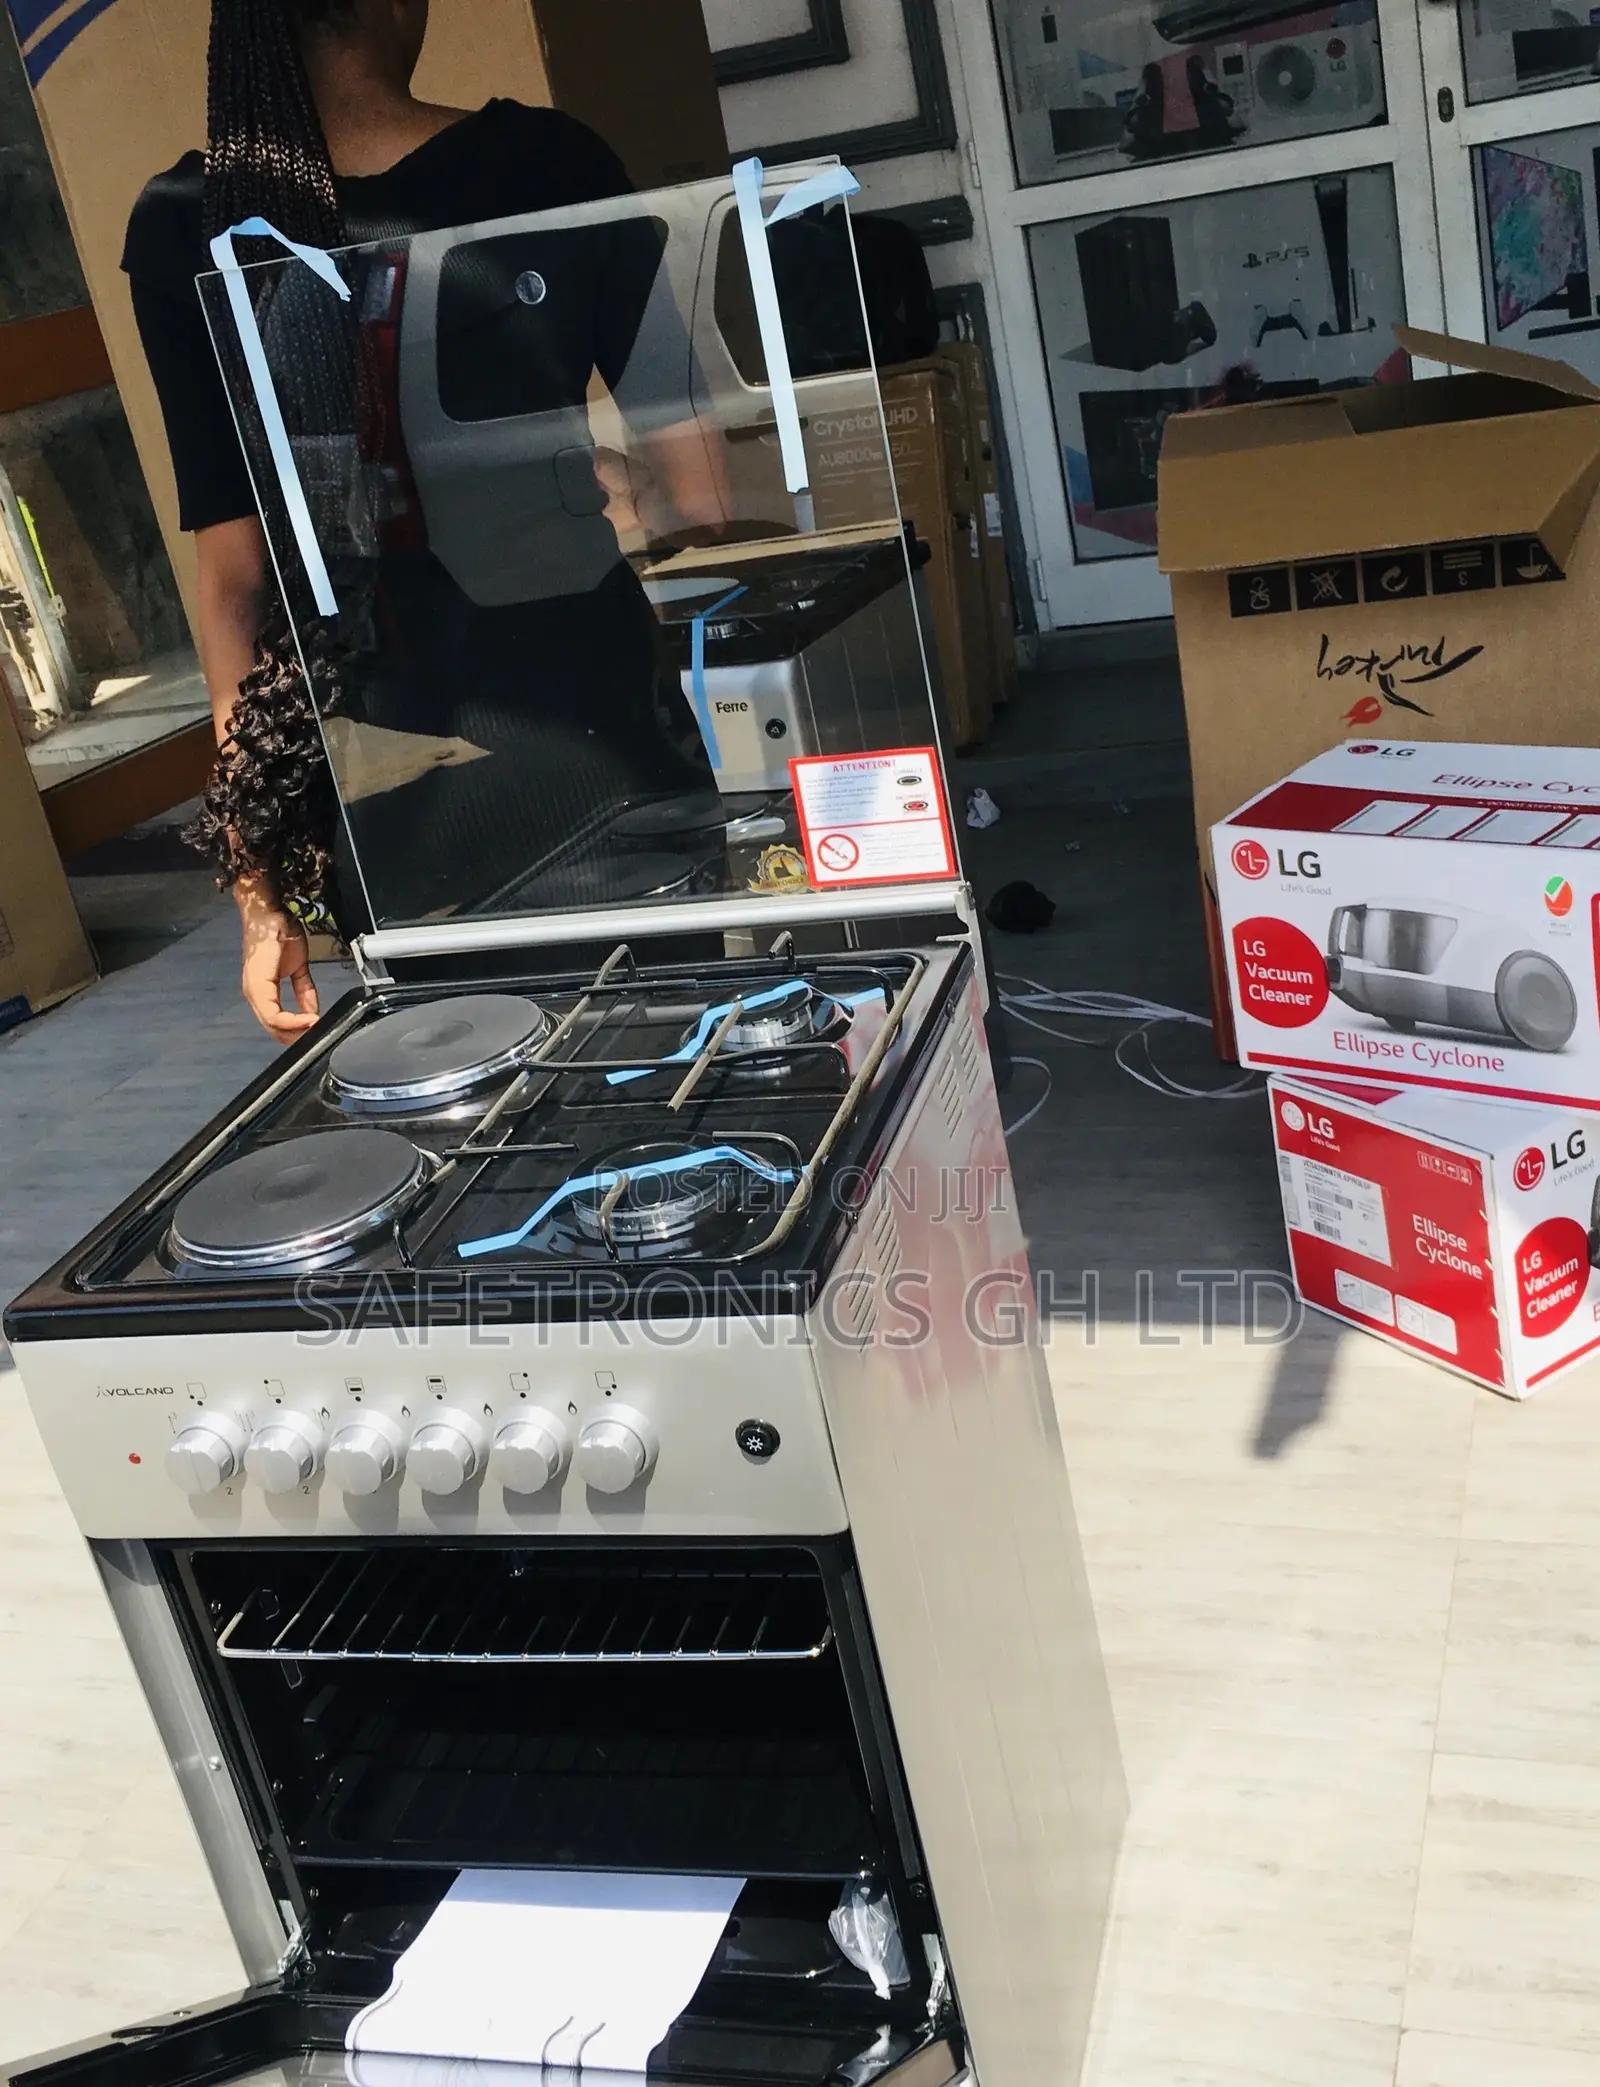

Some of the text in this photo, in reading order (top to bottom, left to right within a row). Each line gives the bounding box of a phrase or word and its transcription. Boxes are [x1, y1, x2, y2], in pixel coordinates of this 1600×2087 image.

[1330, 60, 1347, 72] LG
[1265, 246, 1310, 264] PS5
[813, 410, 879, 438] Crystal
[819, 446, 873, 467] AU8000
[1457, 571, 1469, 586] 3
[715, 701, 749, 715] Ferre
[1380, 747, 1417, 757] LG
[833, 759, 896, 773] ATTENTION!
[1432, 773, 1533, 789] Ellipse
[1277, 848, 1322, 878] LG
[1281, 883, 1332, 896] Life's Good
[1242, 939, 1267, 957] LG
[1244, 961, 1314, 985] Vacuum
[1248, 983, 1313, 1006] Cleaner
[1333, 1031, 1505, 1072] Ellipse Cyclone
[1307, 1112, 1335, 1139] LG
[1550, 1129, 1587, 1170] LG
[1553, 1157, 1595, 1187] Life's Good
[1412, 1213, 1468, 1252] Ellipse
[1416, 1236, 1483, 1280] Cyclone
[1522, 1251, 1543, 1275] LG
[1524, 1257, 1579, 1296] Vacuum
[1526, 1280, 1578, 1319] Cleaner
[105, 1386, 175, 1397] VOLCANO
[226, 1486, 234, 1495] 2
[302, 1485, 311, 1494] 2
